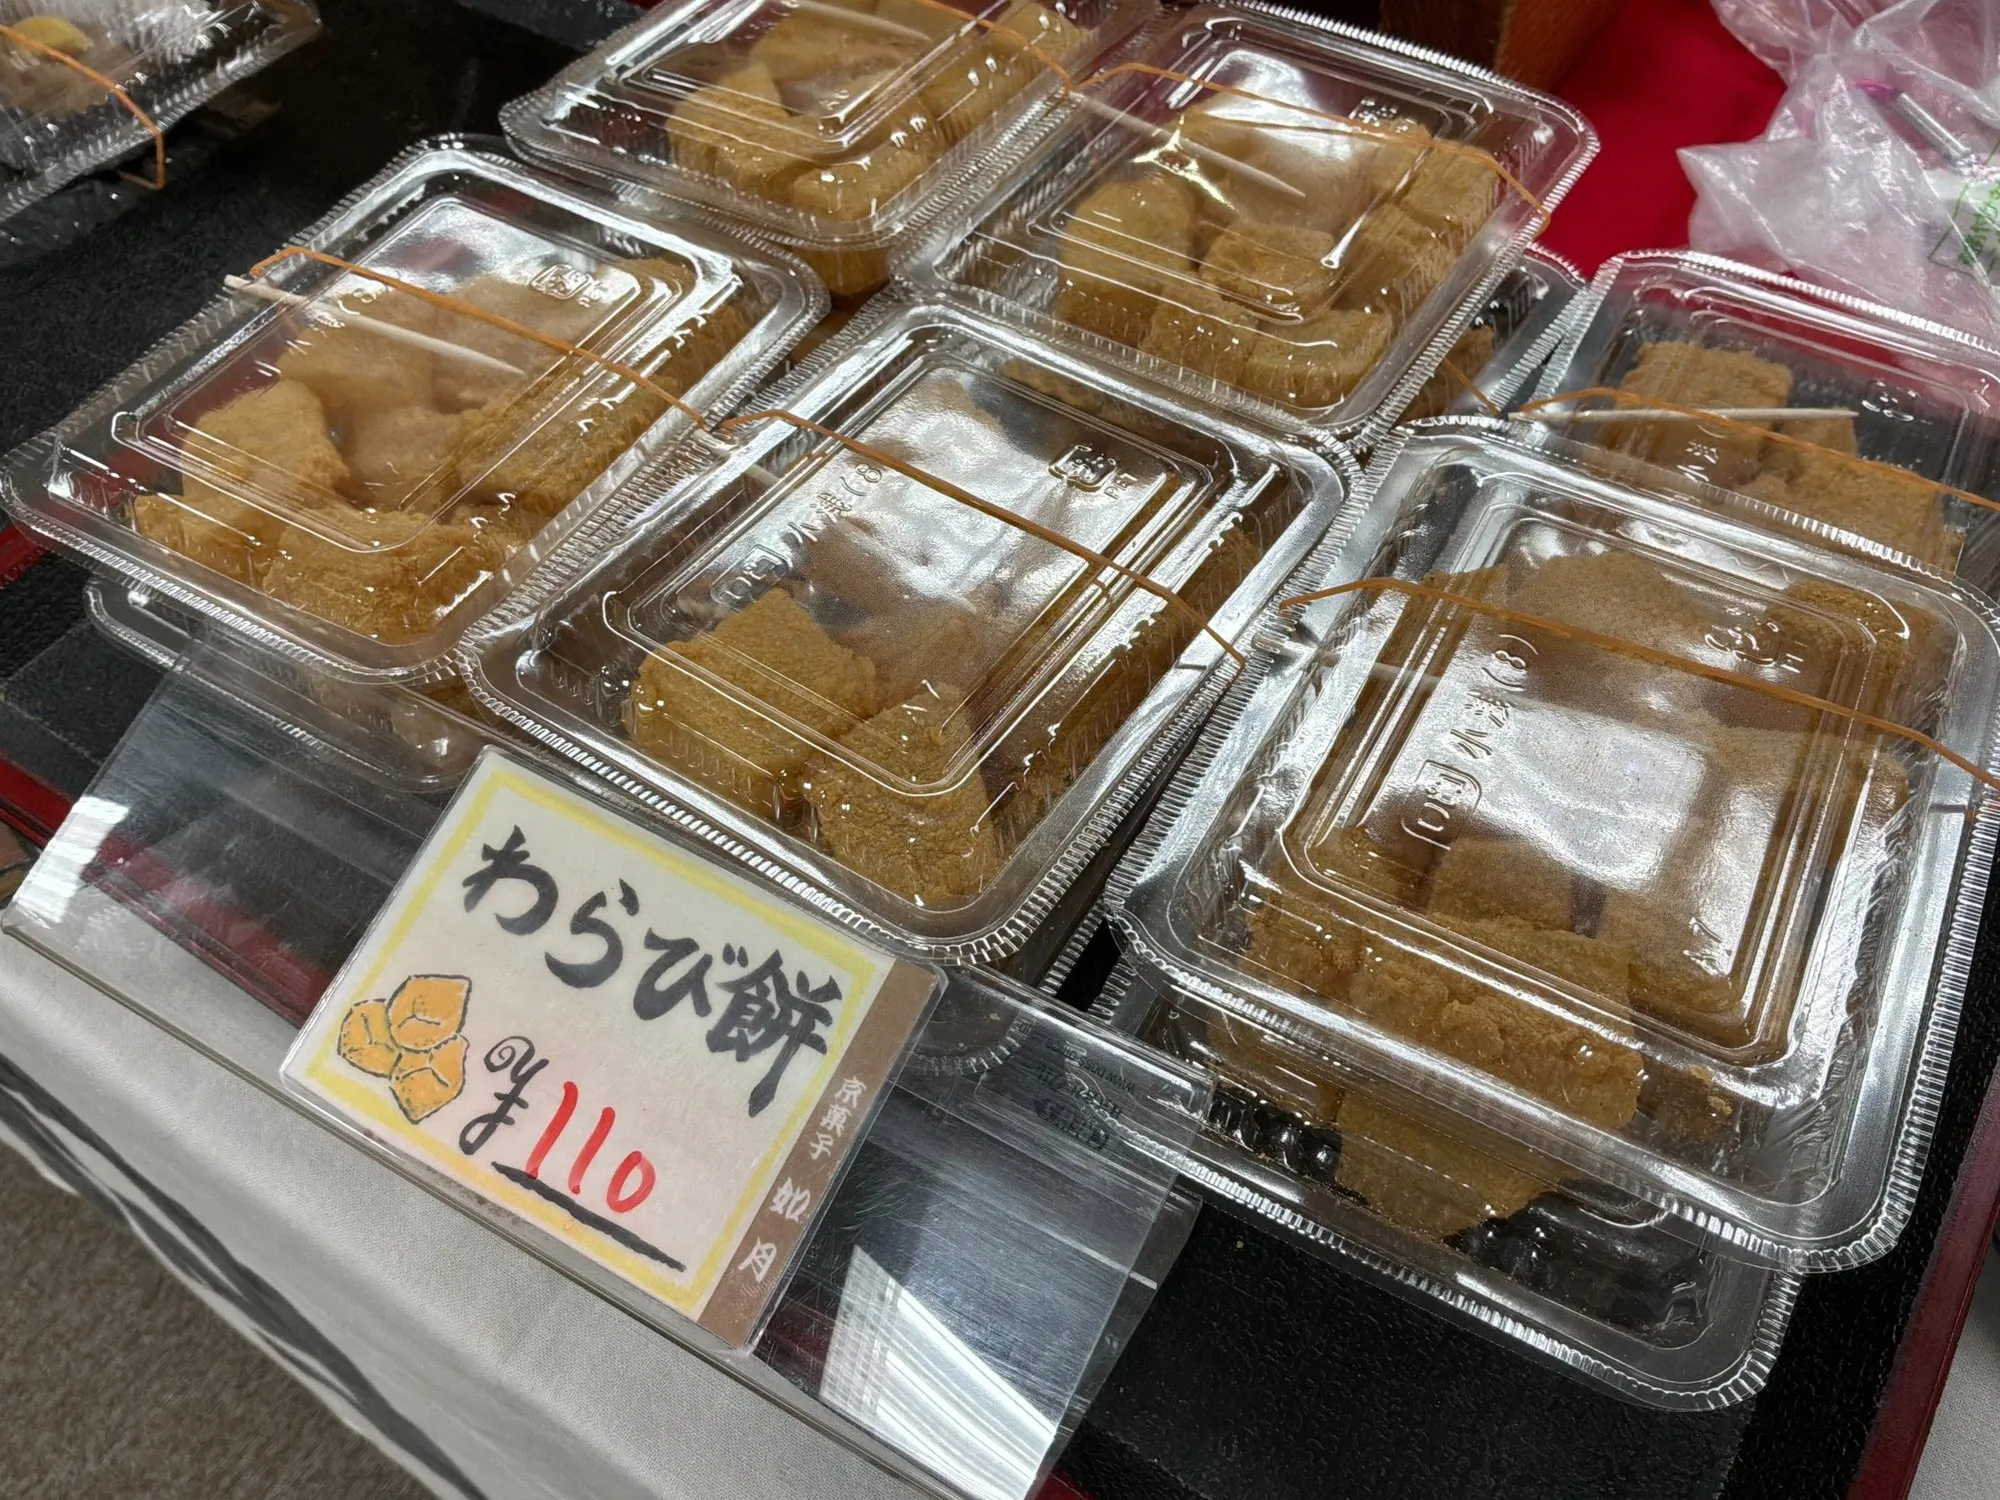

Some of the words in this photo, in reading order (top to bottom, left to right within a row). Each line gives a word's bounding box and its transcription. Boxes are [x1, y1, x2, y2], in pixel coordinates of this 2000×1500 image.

[462, 824, 843, 1118] わらび餅
[809, 1076, 867, 1160] 京菓子
